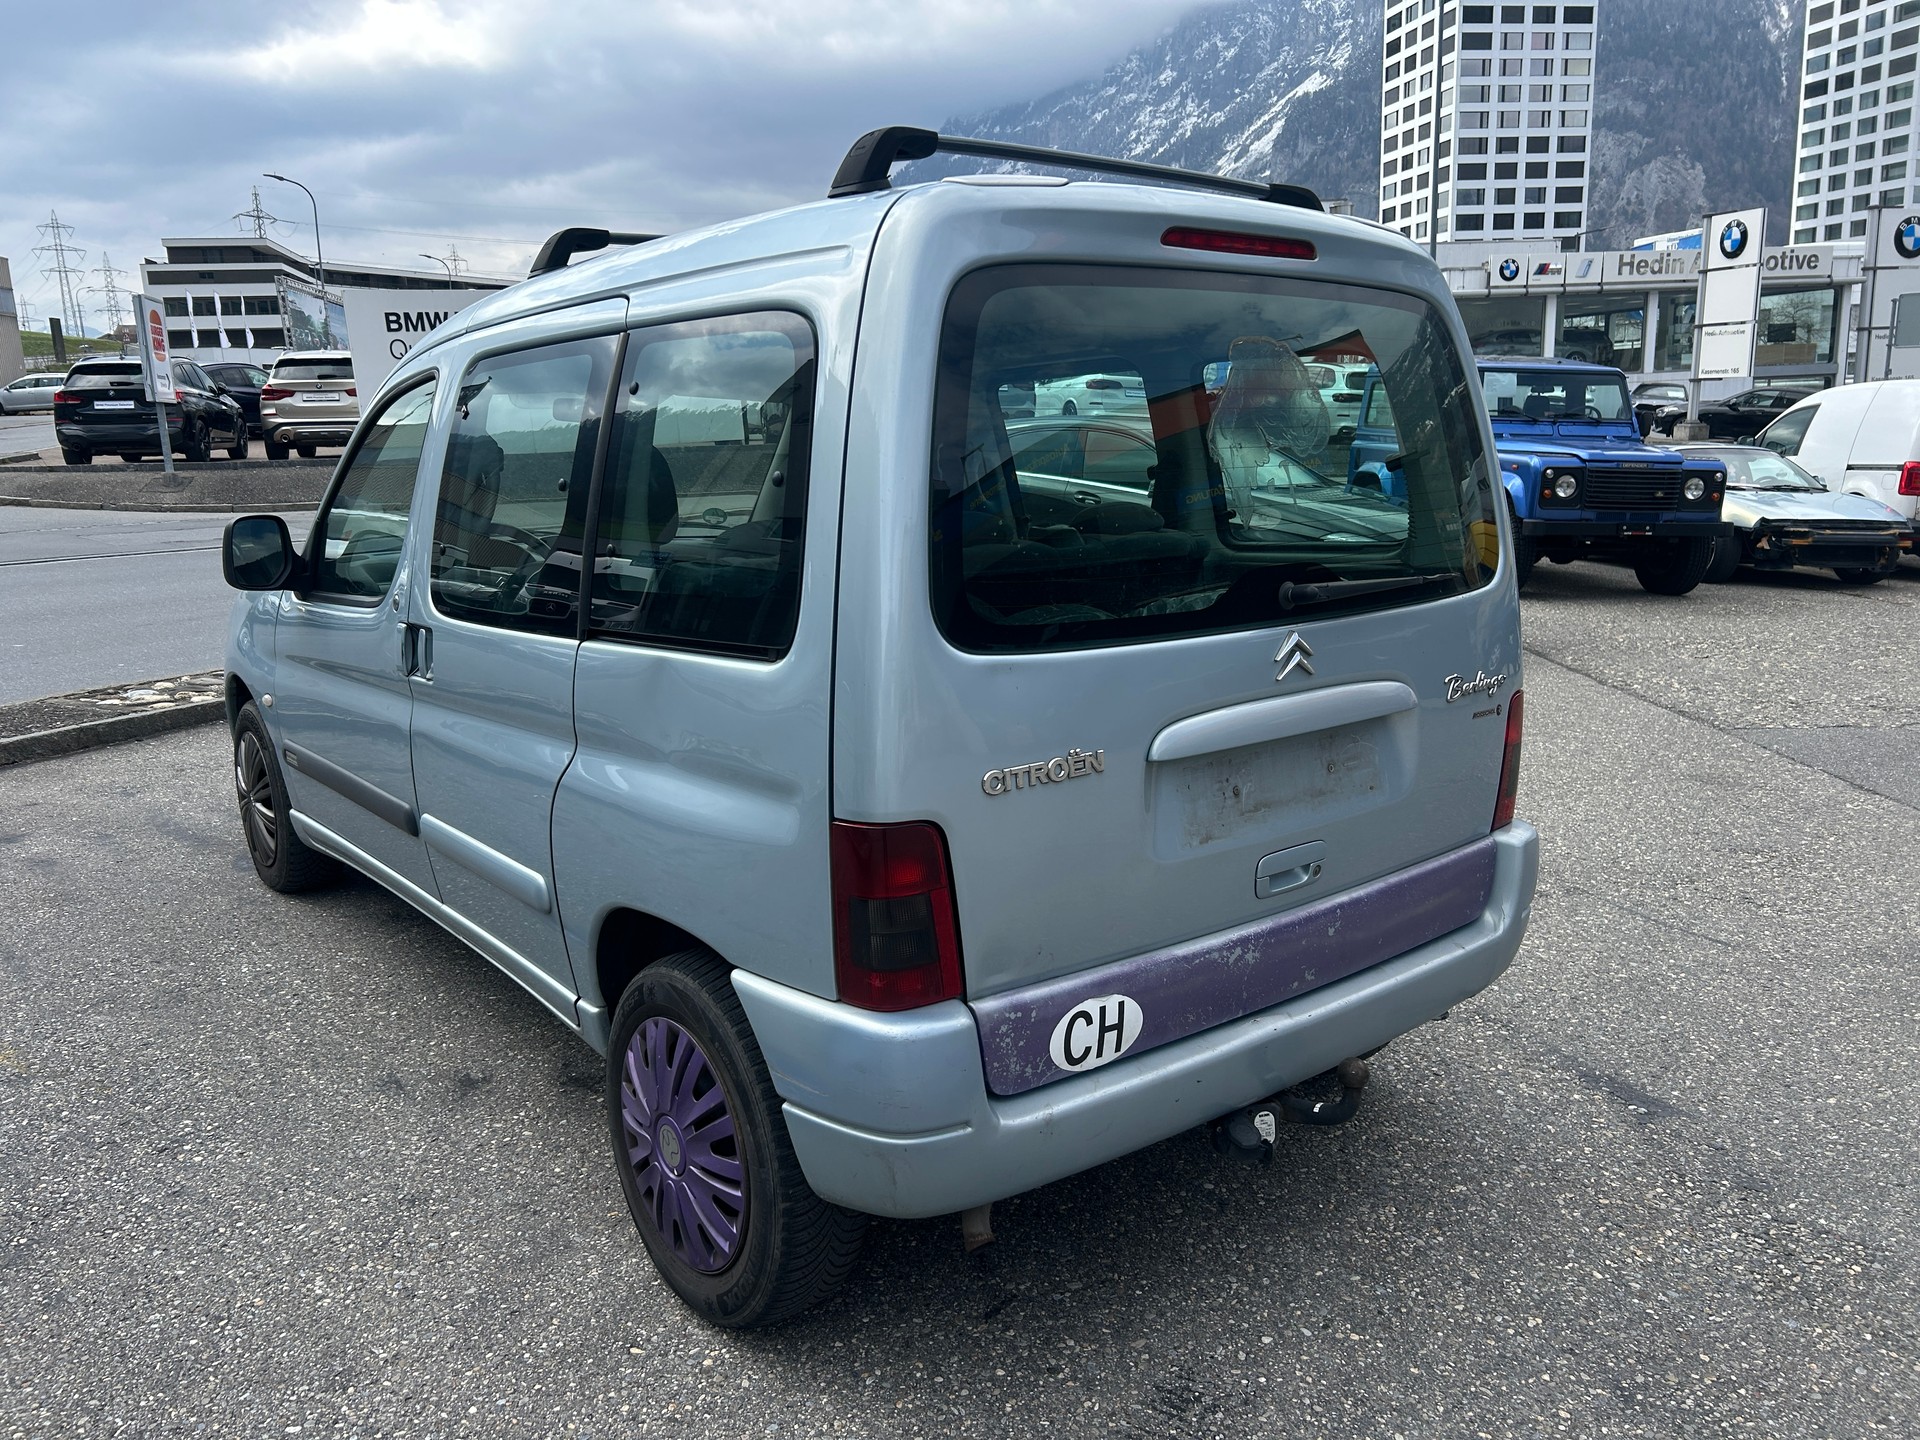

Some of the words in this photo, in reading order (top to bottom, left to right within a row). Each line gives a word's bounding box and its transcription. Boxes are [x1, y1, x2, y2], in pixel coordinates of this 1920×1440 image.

[1618, 252, 1685, 276] Hedin
[1689, 249, 1820, 274] Aotive
[150, 324, 164, 338] BURGER
[384, 311, 449, 333] BMW
[151, 335, 166, 353] KING
[1444, 670, 1507, 703] Berlingo
[981, 748, 1105, 796] CITROËN
[1064, 1000, 1125, 1066] CH
